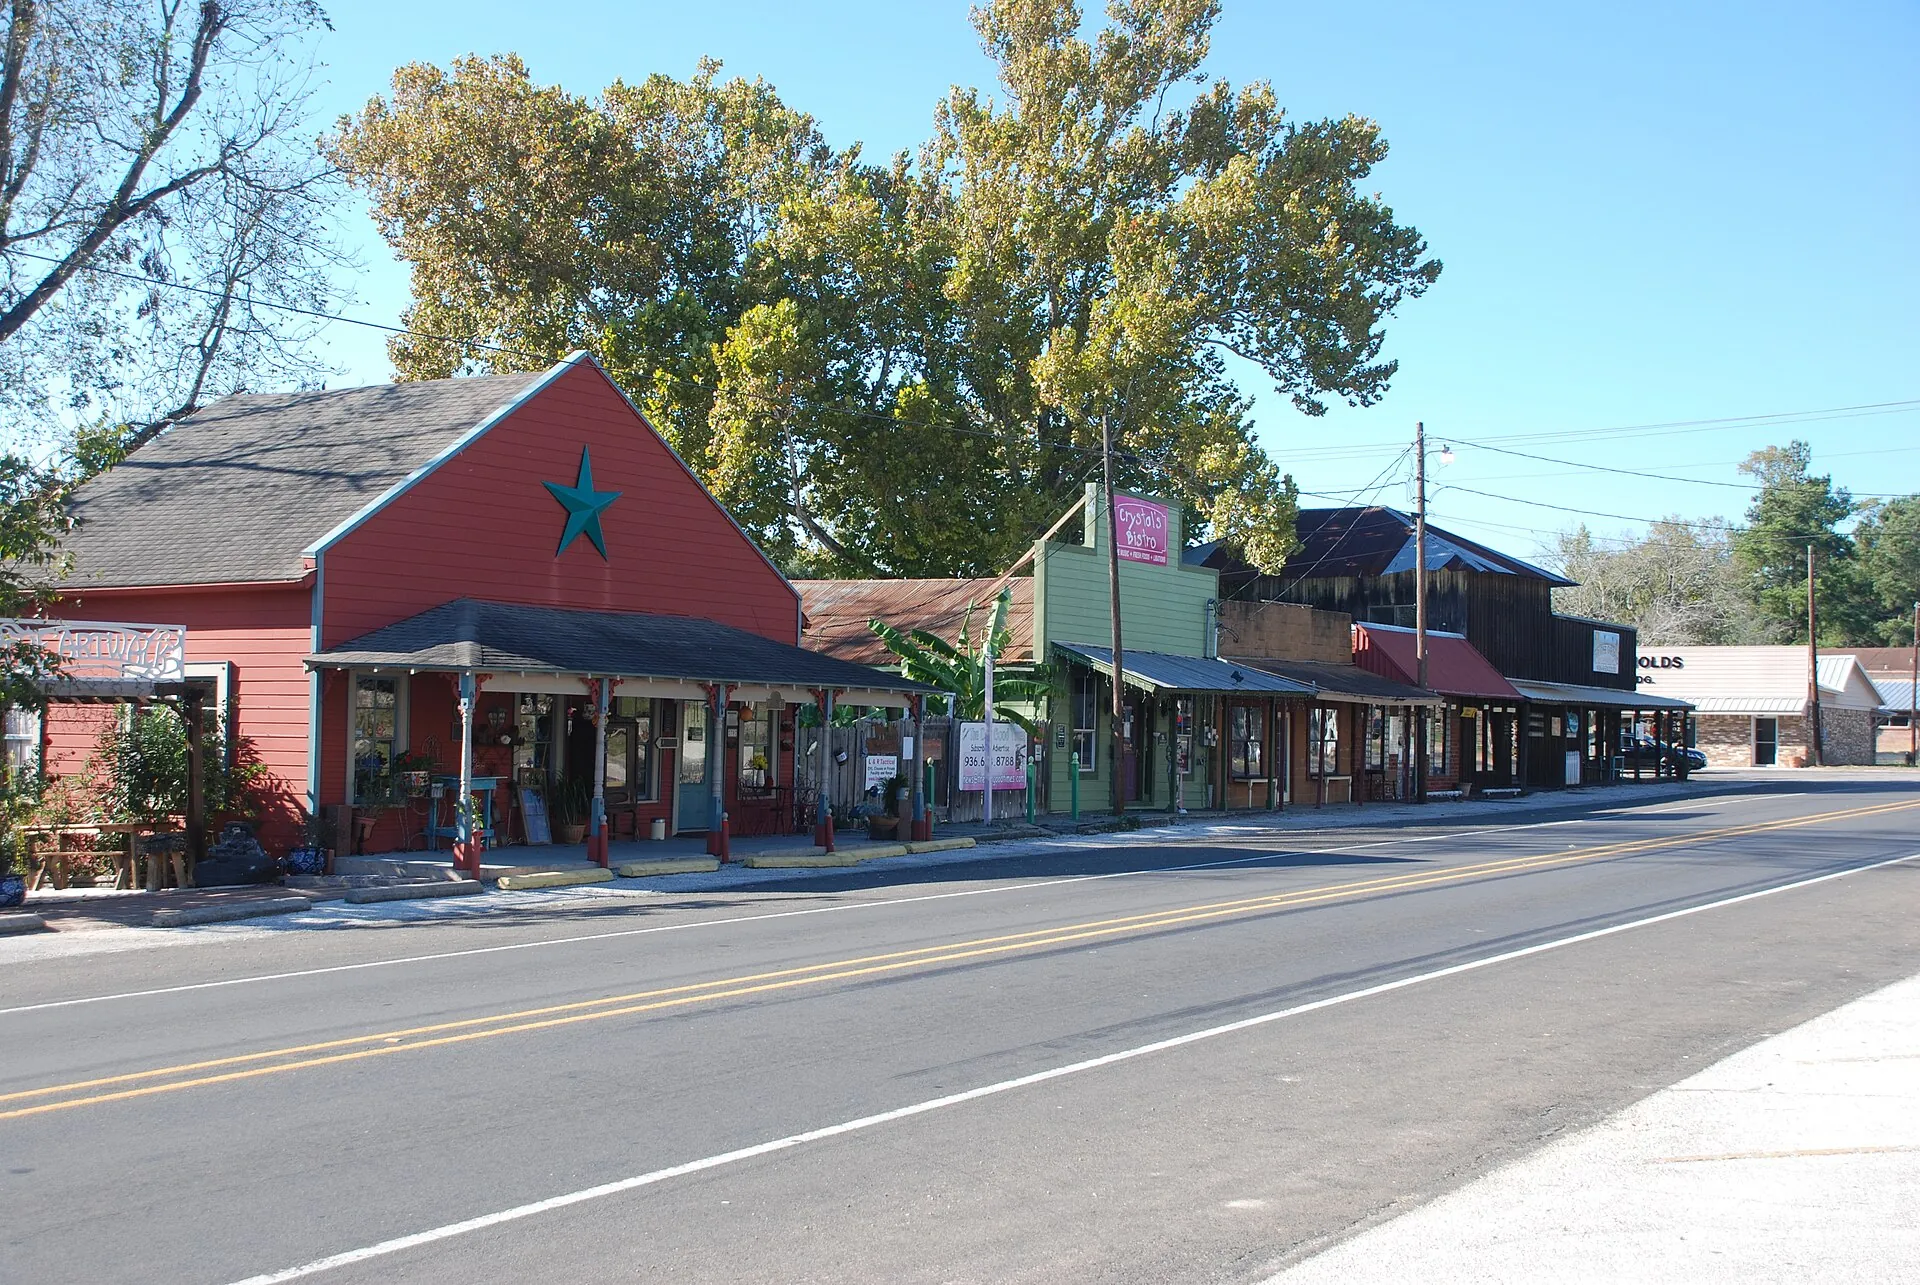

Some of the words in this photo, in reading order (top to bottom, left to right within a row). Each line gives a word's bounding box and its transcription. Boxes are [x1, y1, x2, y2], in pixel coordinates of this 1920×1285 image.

[1119, 508, 1162, 530] Crystal's
[1126, 529, 1157, 549] Bistro
[1638, 656, 1684, 669] OLDS
[971, 744, 985, 752] Subscrib
[964, 756, 1014, 767] 936.6.8788
